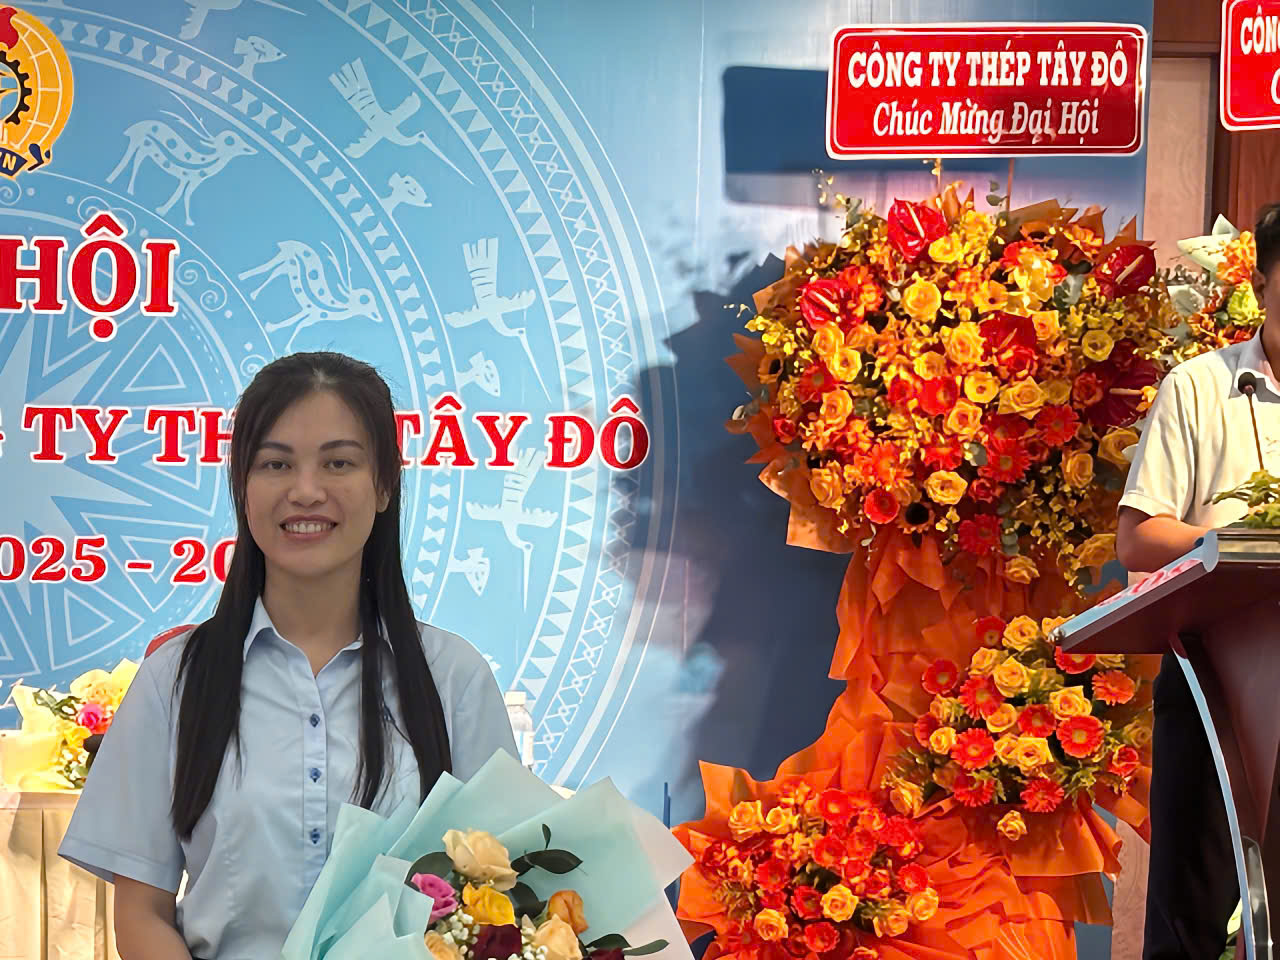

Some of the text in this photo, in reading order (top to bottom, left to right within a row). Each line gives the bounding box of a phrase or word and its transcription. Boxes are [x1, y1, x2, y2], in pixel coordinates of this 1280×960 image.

[1240, 4, 1280, 55] CÔN
[848, 40, 1128, 89] CÔNG TY THÉP TÂY ĐÔ
[873, 99, 1099, 145] Chúc Mừng Đại Hội
[23, 405, 130, 463] TY
[146, 408, 234, 465] TH
[545, 396, 650, 470] ĐÔ
[126, 560, 154, 572] -
[171, 537, 237, 583] 20
